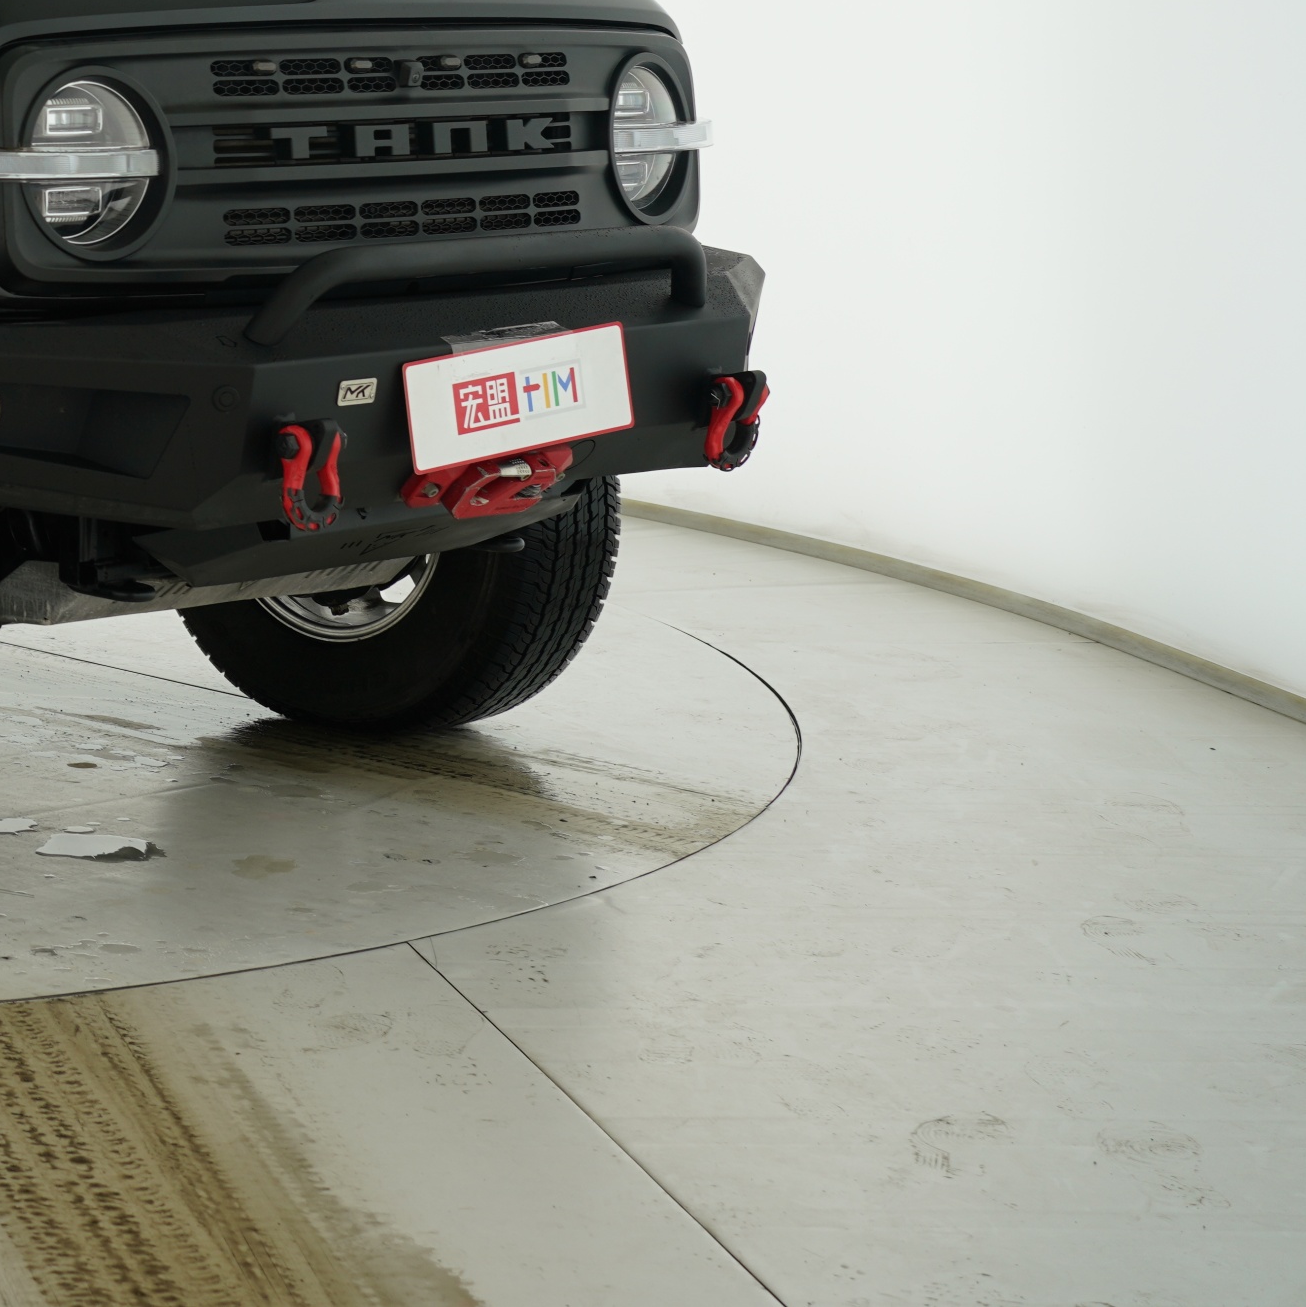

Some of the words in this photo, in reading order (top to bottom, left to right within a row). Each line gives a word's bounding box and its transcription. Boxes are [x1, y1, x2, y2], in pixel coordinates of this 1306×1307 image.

[270, 117, 555, 160] TANK
[342, 384, 371, 400] MK
[459, 377, 520, 429] 宏盟
